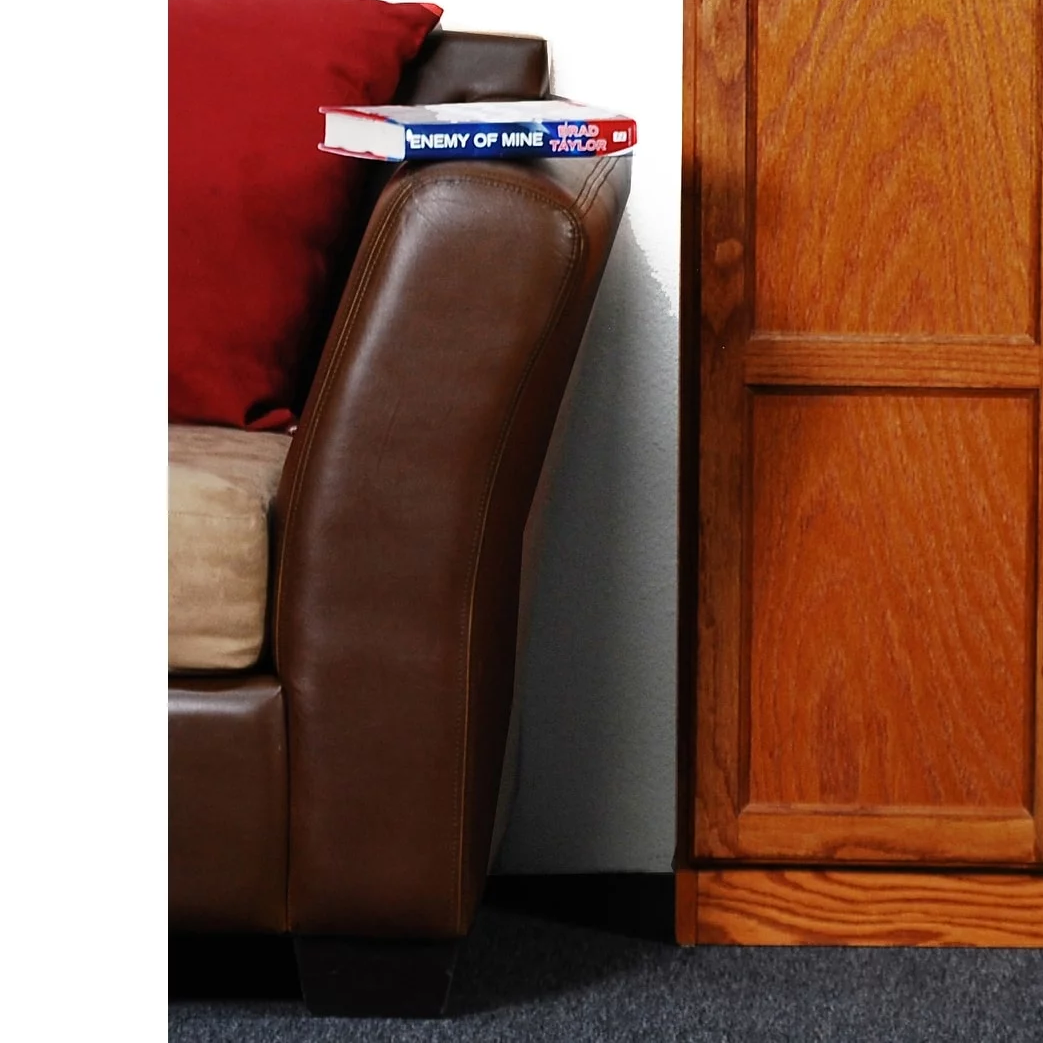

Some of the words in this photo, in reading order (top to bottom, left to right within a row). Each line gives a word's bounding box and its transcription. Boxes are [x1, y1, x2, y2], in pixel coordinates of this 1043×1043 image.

[557, 123, 600, 138] BRAD
[409, 132, 470, 150] ENEMY
[473, 132, 498, 148] OF
[501, 131, 544, 148] MINE
[549, 138, 607, 153] TAYLOR
